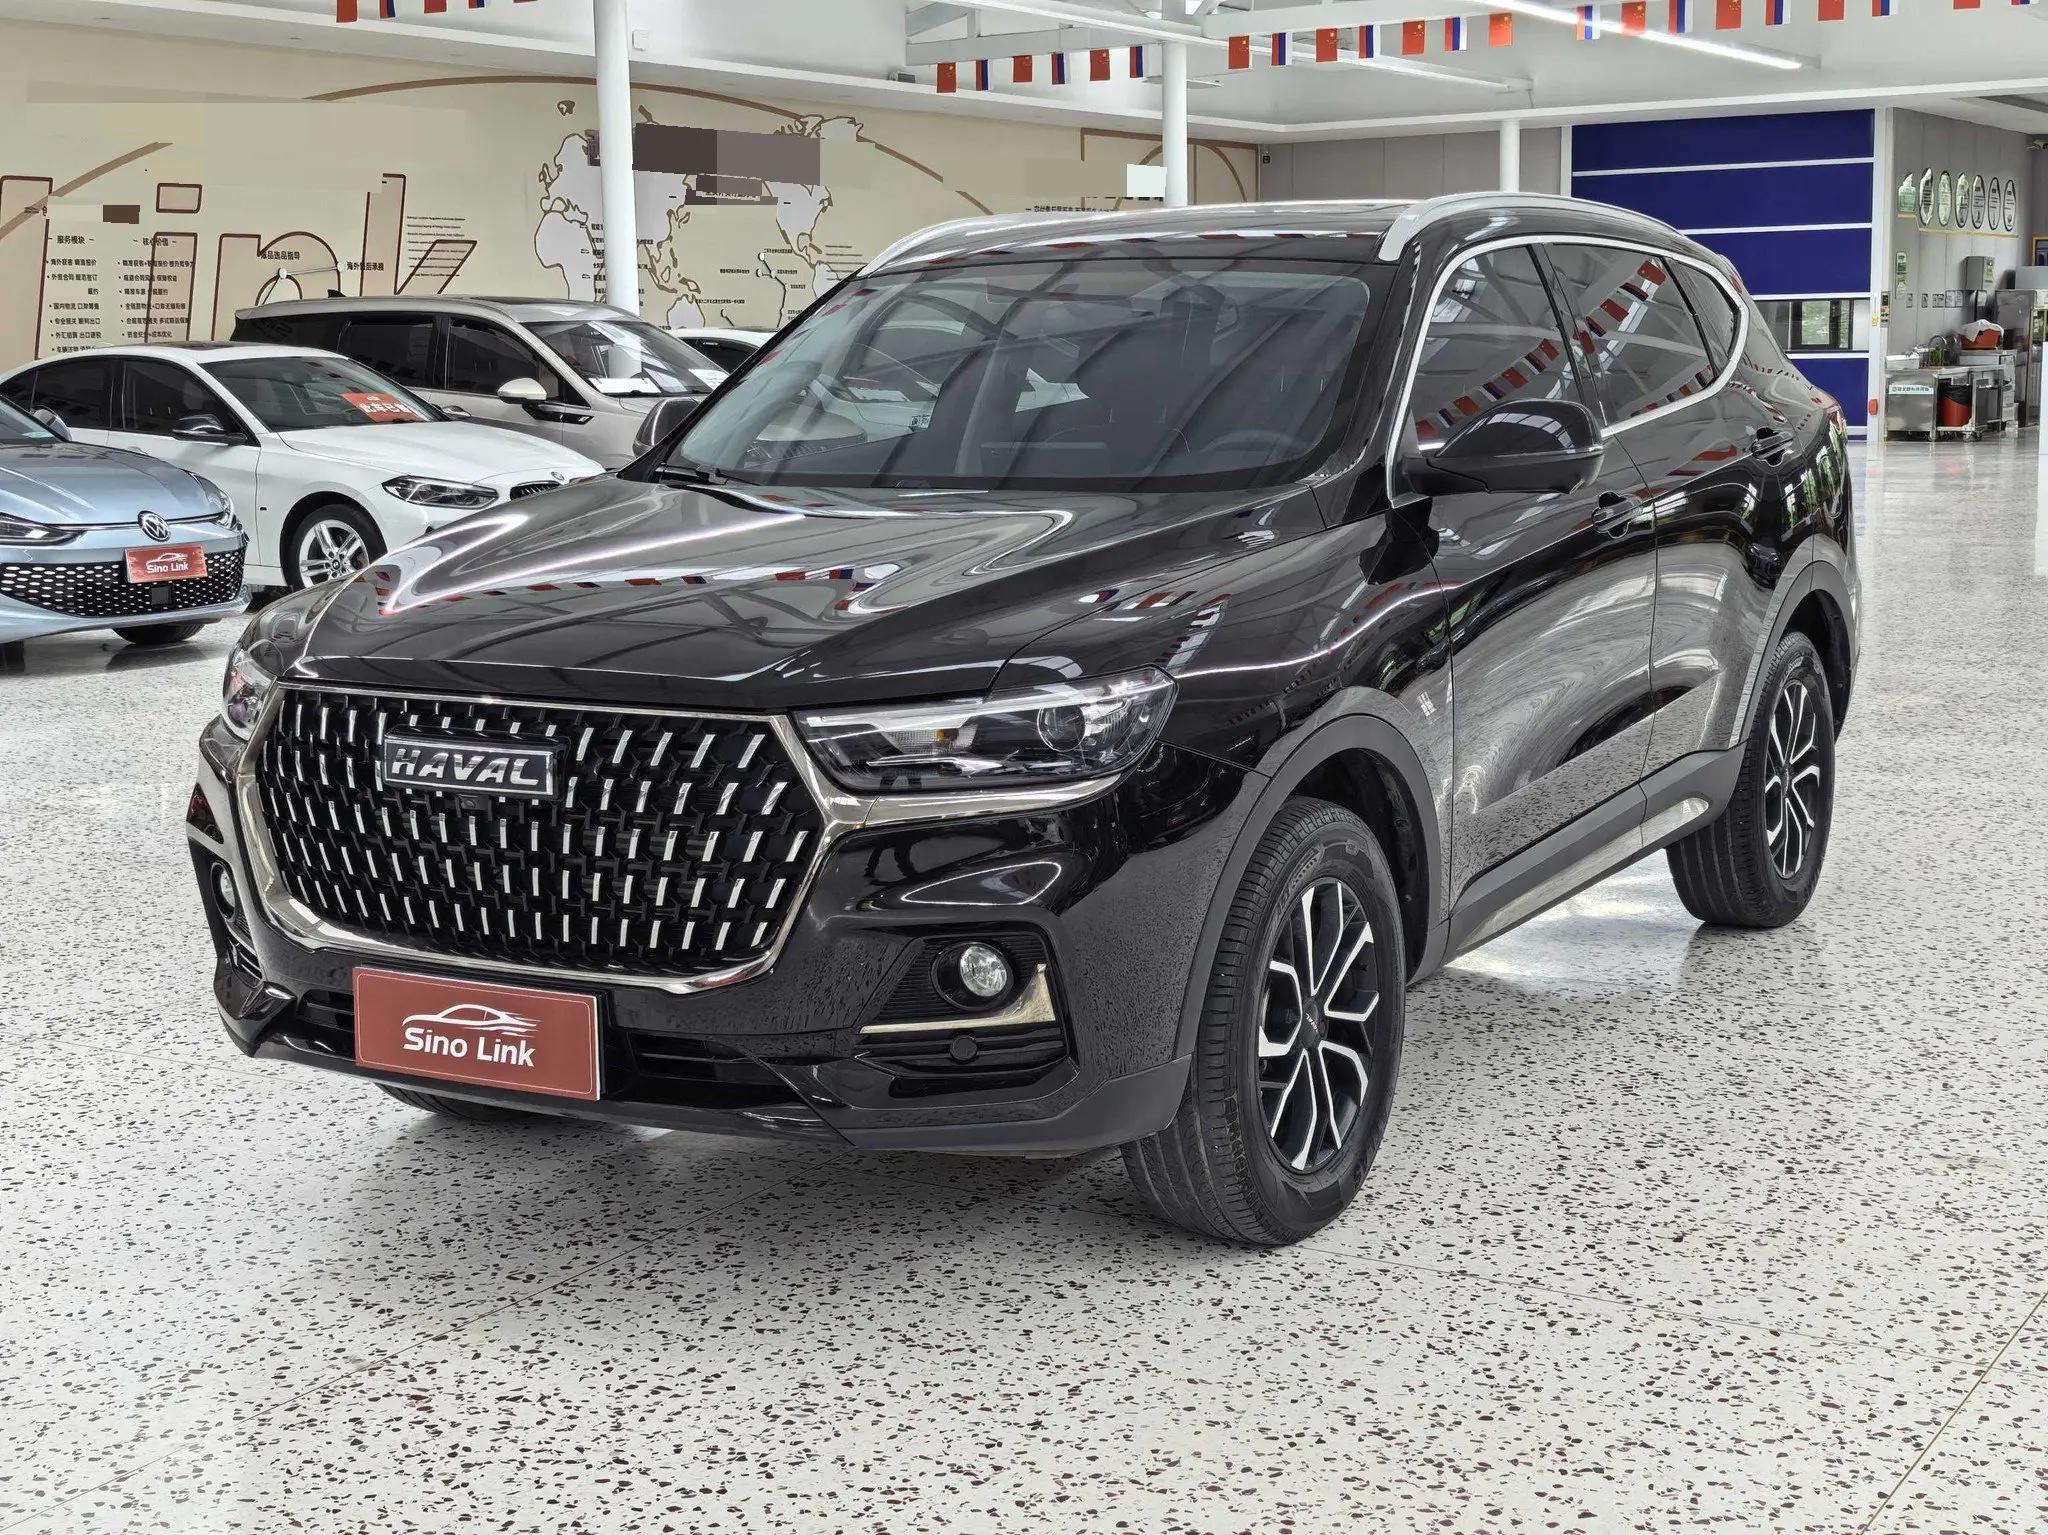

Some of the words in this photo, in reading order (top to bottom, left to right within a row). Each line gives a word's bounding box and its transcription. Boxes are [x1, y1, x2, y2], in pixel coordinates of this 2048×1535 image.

[57, 235, 86, 245] 服务模块
[142, 237, 169, 247] 核心价值
[146, 563, 169, 574] Sino
[170, 561, 189, 572] Link
[391, 747, 540, 786] HAVAL
[402, 1026, 468, 1059] Sino
[476, 1034, 536, 1068] Link
